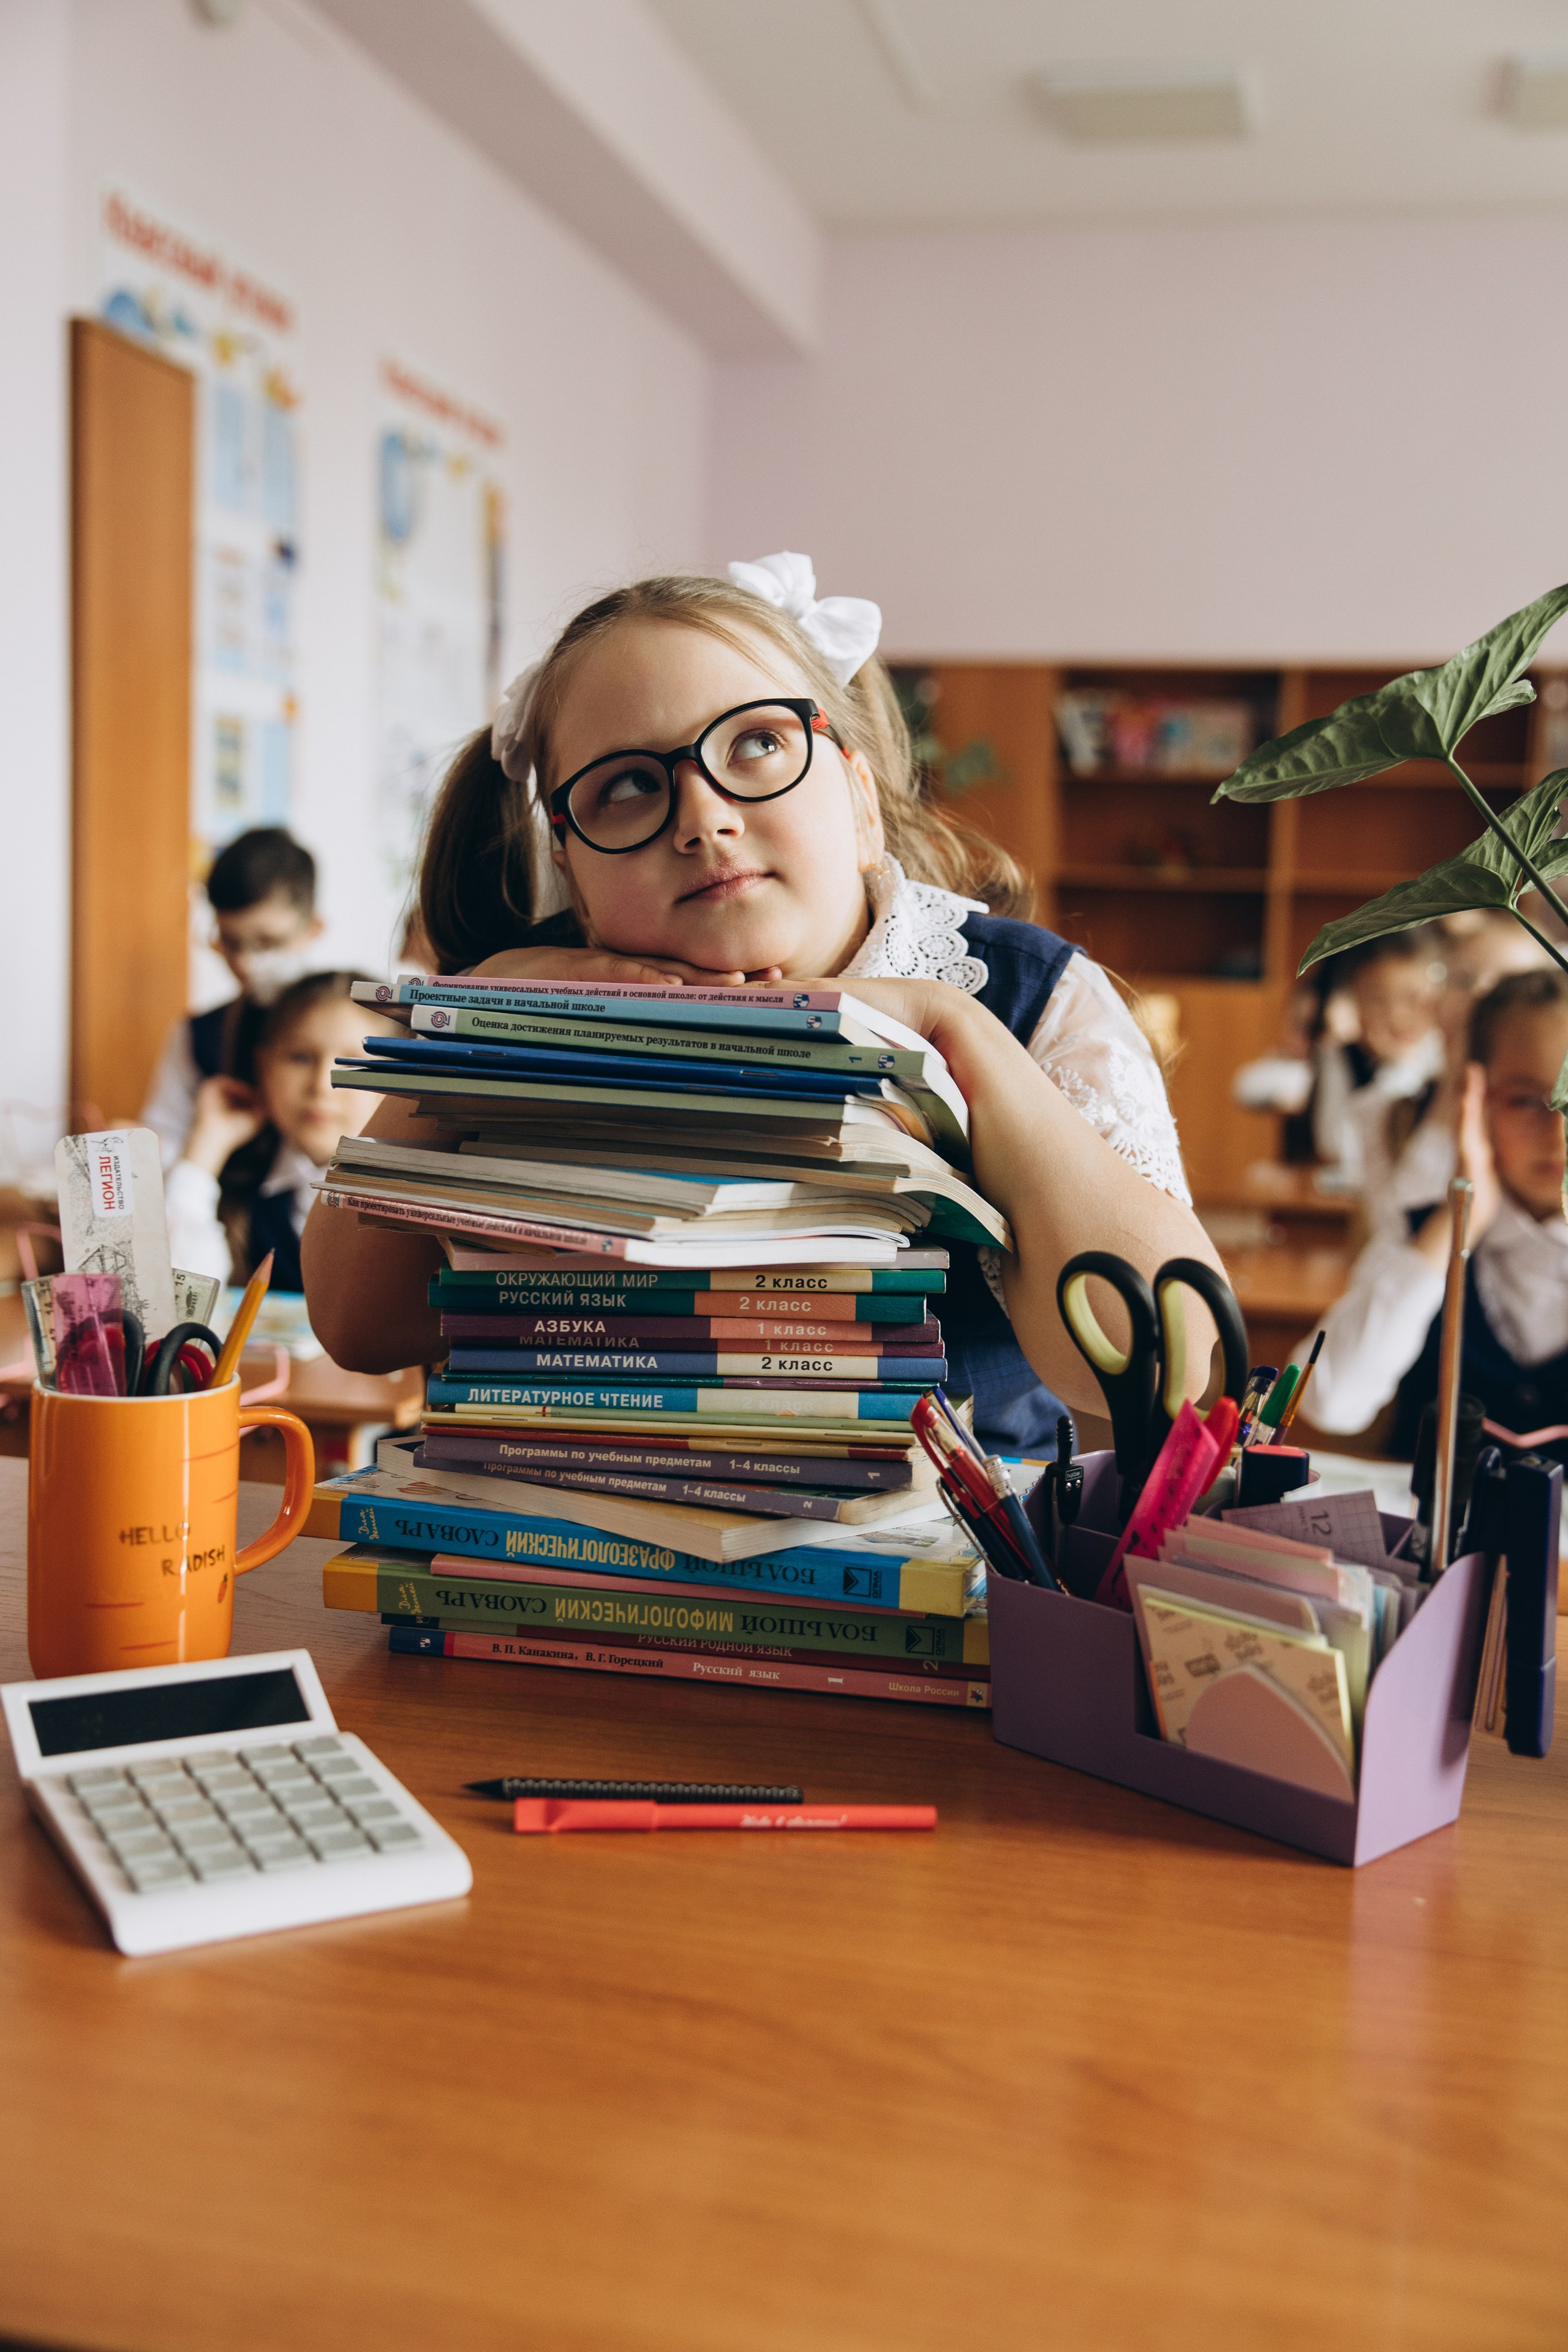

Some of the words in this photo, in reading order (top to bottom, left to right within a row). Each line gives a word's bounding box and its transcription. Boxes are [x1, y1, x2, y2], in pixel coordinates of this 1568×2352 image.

[409, 989, 467, 1003] Проектные
[468, 996, 504, 1006] задачи
[513, 998, 570, 1011] начальной
[571, 1003, 606, 1014] школе
[490, 984, 549, 994] универсальных
[551, 987, 583, 996] учебных
[585, 988, 622, 998] действий
[630, 989, 667, 999] основной
[668, 992, 697, 1000] школе:
[708, 993, 747, 1003] действия
[472, 1016, 509, 1030] Оценка
[510, 1022, 572, 1036] достижения
[573, 1029, 645, 1043] планируемых
[646, 1035, 709, 1049] результатов
[710, 1041, 717, 1050] в
[718, 1042, 775, 1056] начальной
[776, 1046, 812, 1060] школе
[99, 1156, 116, 1210] ЛЕГИОН
[113, 1155, 125, 1210] ИЗДАТЕЛЬСТВО
[347, 1196, 360, 1207] Как
[360, 1200, 405, 1216] проектировать
[405, 1207, 456, 1224] универсальные
[455, 1215, 484, 1229] учебные
[175, 1273, 186, 1286] 15
[496, 1271, 616, 1289] ОКРУЖАЮЩИЙ
[622, 1273, 658, 1288] МИР
[755, 1274, 766, 1288] 2
[772, 1277, 828, 1289] класс
[499, 1290, 574, 1306] РУССКИЙ
[579, 1294, 627, 1308] ЯЗЫК
[739, 1296, 750, 1310] 2
[756, 1298, 812, 1313] класс
[534, 1319, 606, 1333] АЗБУКА
[757, 1322, 765, 1335] 1
[774, 1324, 827, 1336] класс
[519, 1336, 640, 1348] МАТЕМАТИКА
[764, 1339, 772, 1351] 1
[780, 1341, 834, 1352] класс
[536, 1354, 658, 1368] МАТЕМАТИКА
[761, 1356, 772, 1370] 2
[778, 1359, 834, 1372] класс
[467, 1388, 595, 1406] ЛИТЕРАТУРНОЕ
[600, 1395, 663, 1408] ЧТЕНИЕ
[499, 1444, 568, 1459] Программы
[571, 1450, 586, 1460] по
[588, 1451, 642, 1463] учебным
[646, 1455, 712, 1469] предметам
[753, 1463, 801, 1474] классы
[545, 1469, 556, 1478] по
[559, 1471, 606, 1485] учебным
[608, 1477, 667, 1493] предметам
[703, 1489, 747, 1503] классы
[119, 1523, 190, 1546] HELLO
[394, 1519, 499, 1547] СЛОВАРЬ
[1310, 1510, 1333, 1536] 12
[505, 1529, 676, 1570] ФРАЗЕОЛОГИЧЕСКИЙ
[682, 1553, 817, 1585] БОЛЬШОЙ
[435, 1589, 547, 1614] СЛОВАРЬ
[554, 1597, 734, 1632] МИФОЛОГИЧЕСКИЙ
[740, 1614, 878, 1643] БОЛЬШОЙ
[756, 1645, 793, 1657] ЯЗЫК
[492, 1643, 502, 1654] В.
[504, 1644, 516, 1655] П.
[518, 1645, 578, 1662] Канакина,
[585, 1651, 595, 1662] В.
[597, 1653, 606, 1664] Г.
[608, 1654, 664, 1668] Горецкий
[693, 1661, 743, 1676] Русский
[748, 1669, 780, 1680] язык
[888, 1681, 921, 1694] Школа
[923, 1685, 960, 1698] России
